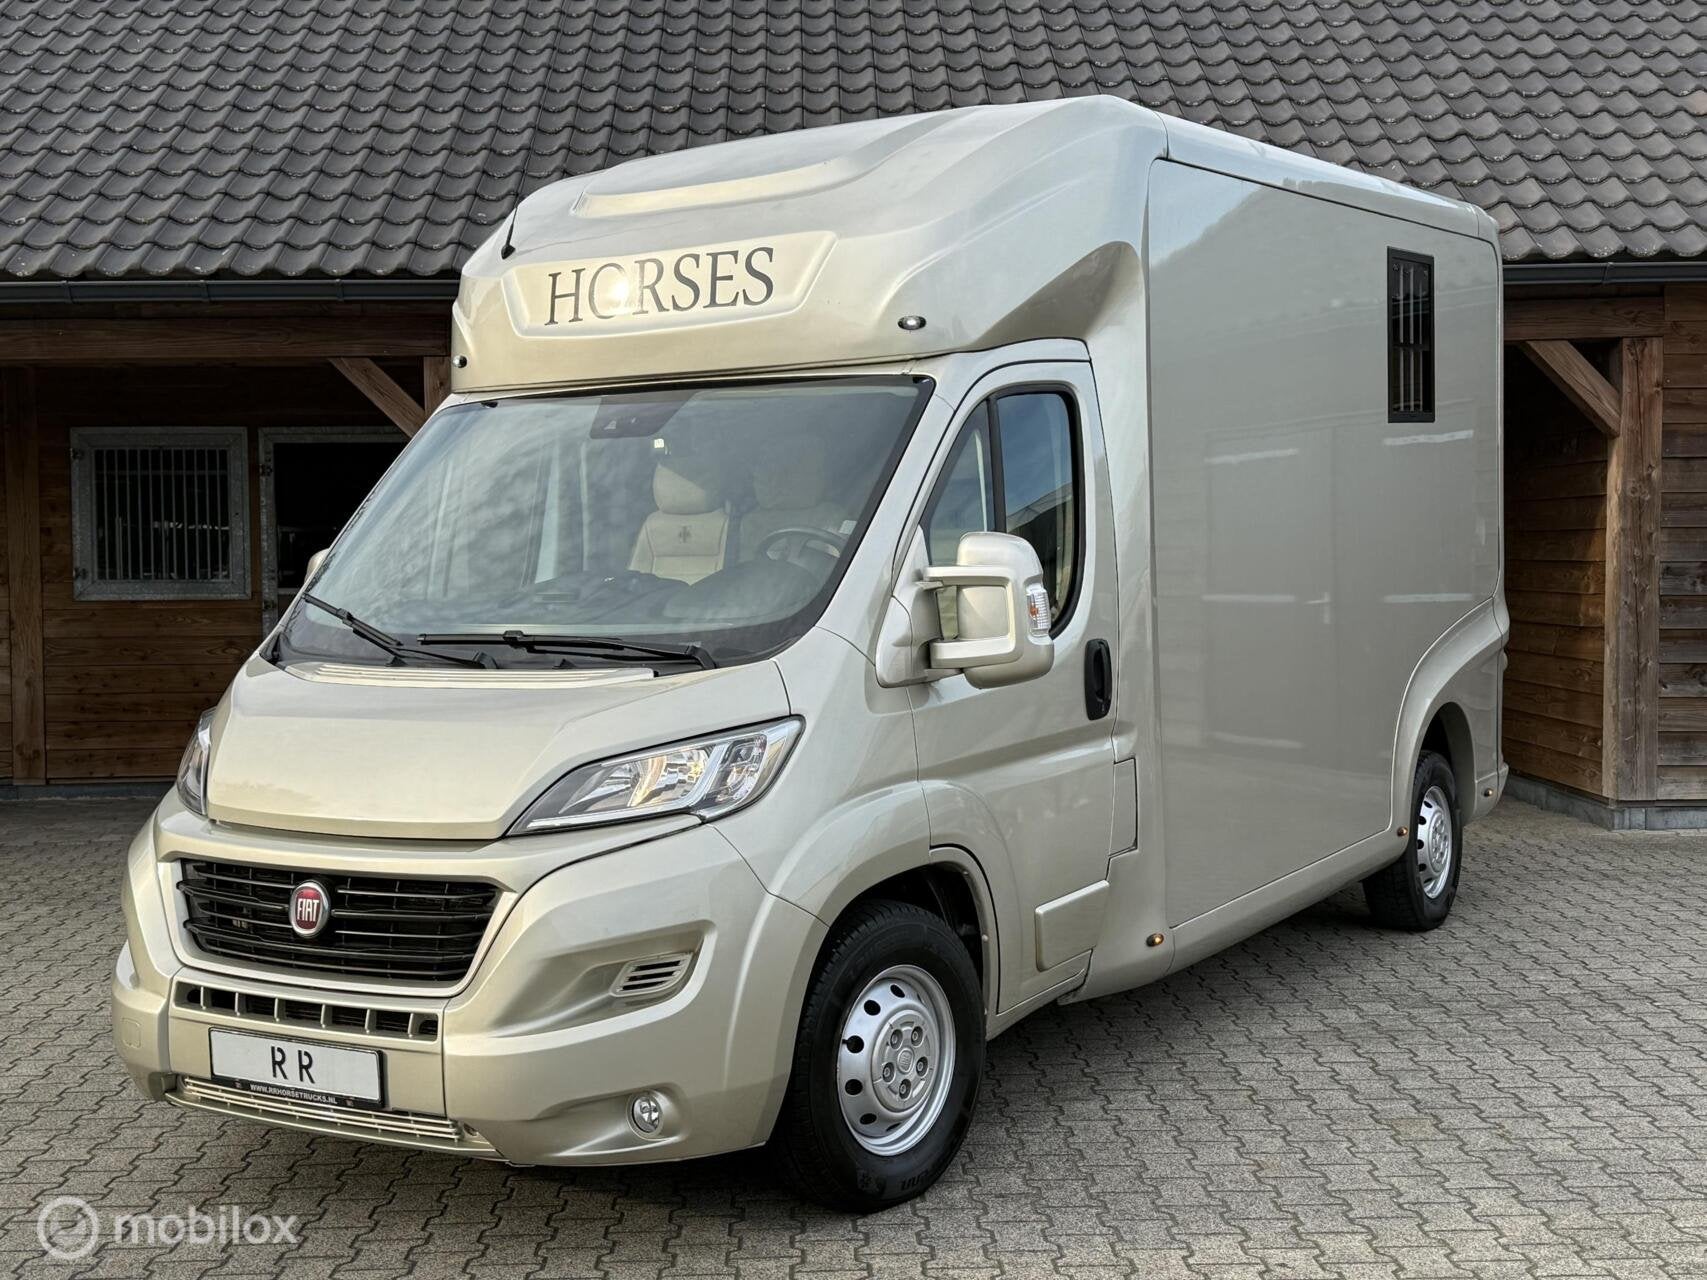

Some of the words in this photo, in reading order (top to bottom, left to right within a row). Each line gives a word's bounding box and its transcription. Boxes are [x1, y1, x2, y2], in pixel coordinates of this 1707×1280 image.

[544, 246, 775, 326] HORSES
[296, 898, 320, 922] FIAT
[249, 1083, 338, 1105] WWW.RRHORSETRUCKS.NL
